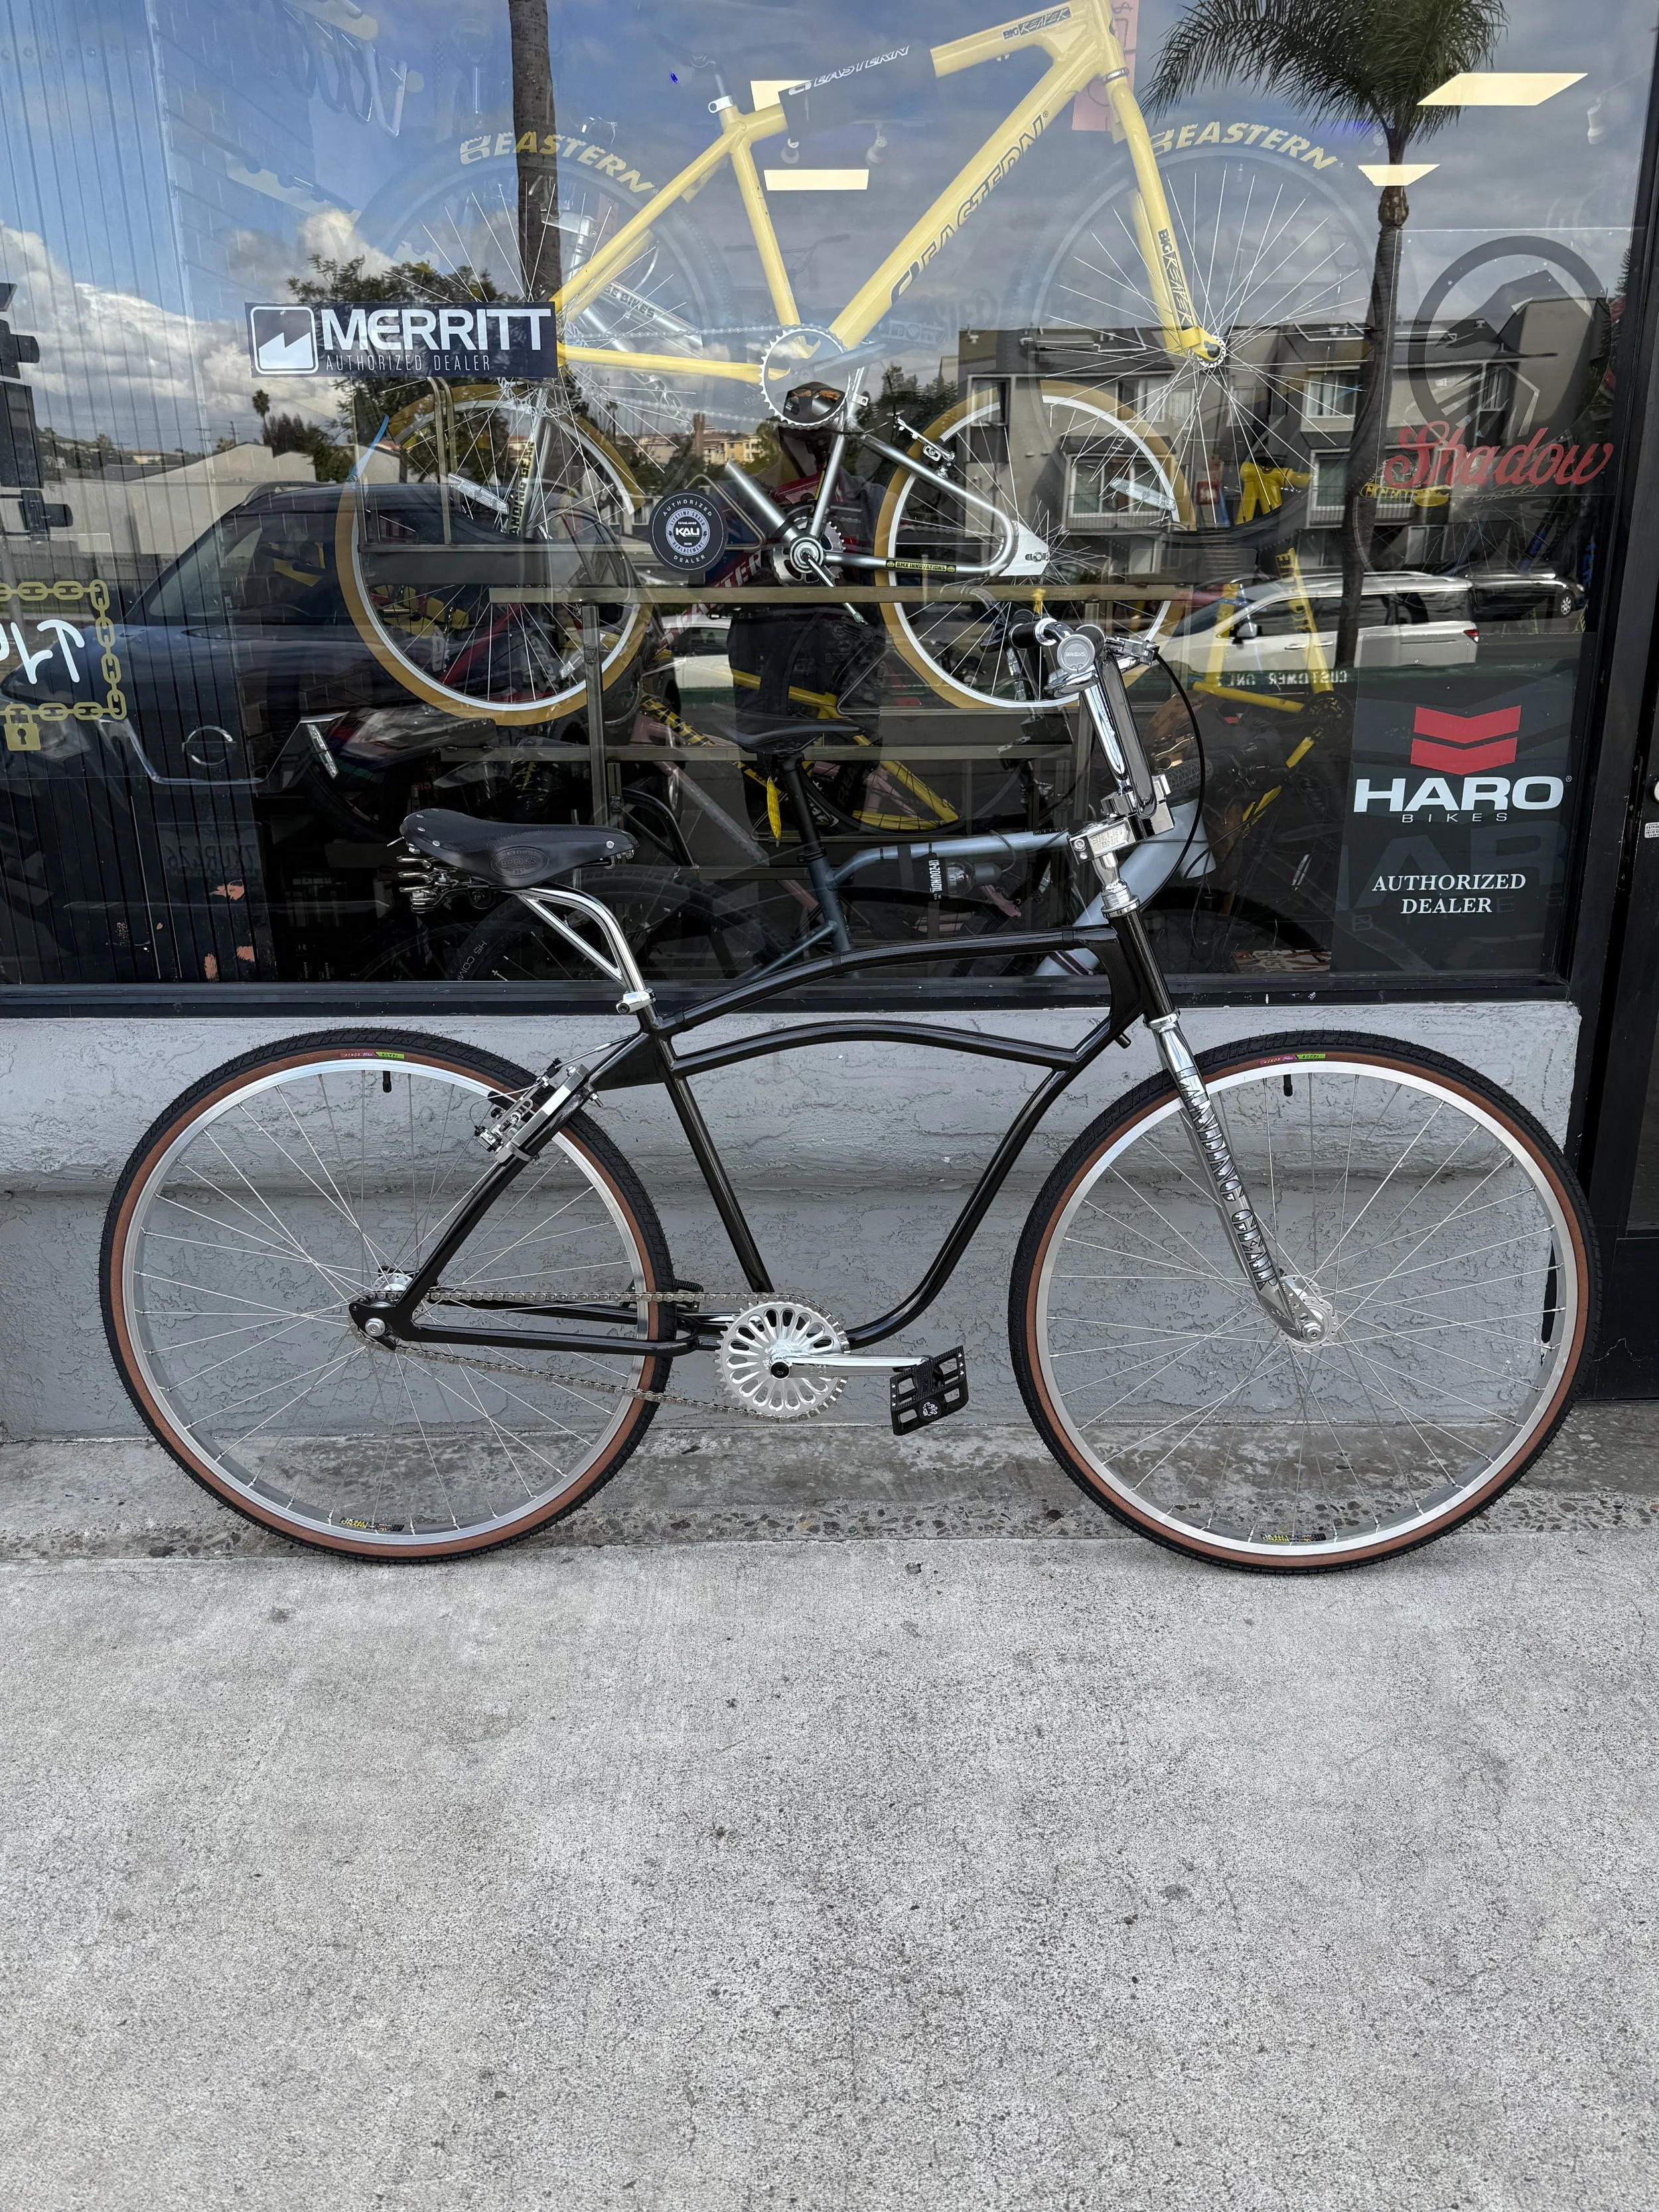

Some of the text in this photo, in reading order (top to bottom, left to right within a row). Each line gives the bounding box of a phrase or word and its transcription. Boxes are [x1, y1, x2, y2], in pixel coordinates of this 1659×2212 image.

[1003, 7, 1071, 40] BIG REAPER
[1175, 121, 1338, 170] EASTERN
[494, 131, 654, 193] EASTERN
[1158, 228, 1194, 328] BIG REAPER
[620, 292, 656, 319] BIKES
[321, 309, 551, 350] MERRITT
[326, 355, 490, 371] AUTHORIZED DEALER
[1384, 421, 1614, 488] Shadow
[663, 499, 712, 516] AUTHORIZED
[672, 542, 705, 553] REPLACEMENT
[676, 528, 700, 538] KALI
[674, 554, 705, 563] DEALER
[0, 619, 85, 684] LT
[1354, 776, 1563, 812] HARO
[1402, 812, 1508, 823] BIKES
[1372, 874, 1526, 891] AUTHORIZED
[1400, 898, 1492, 915] DEALER
[1175, 1066, 1279, 1291] LANDING GEAR
